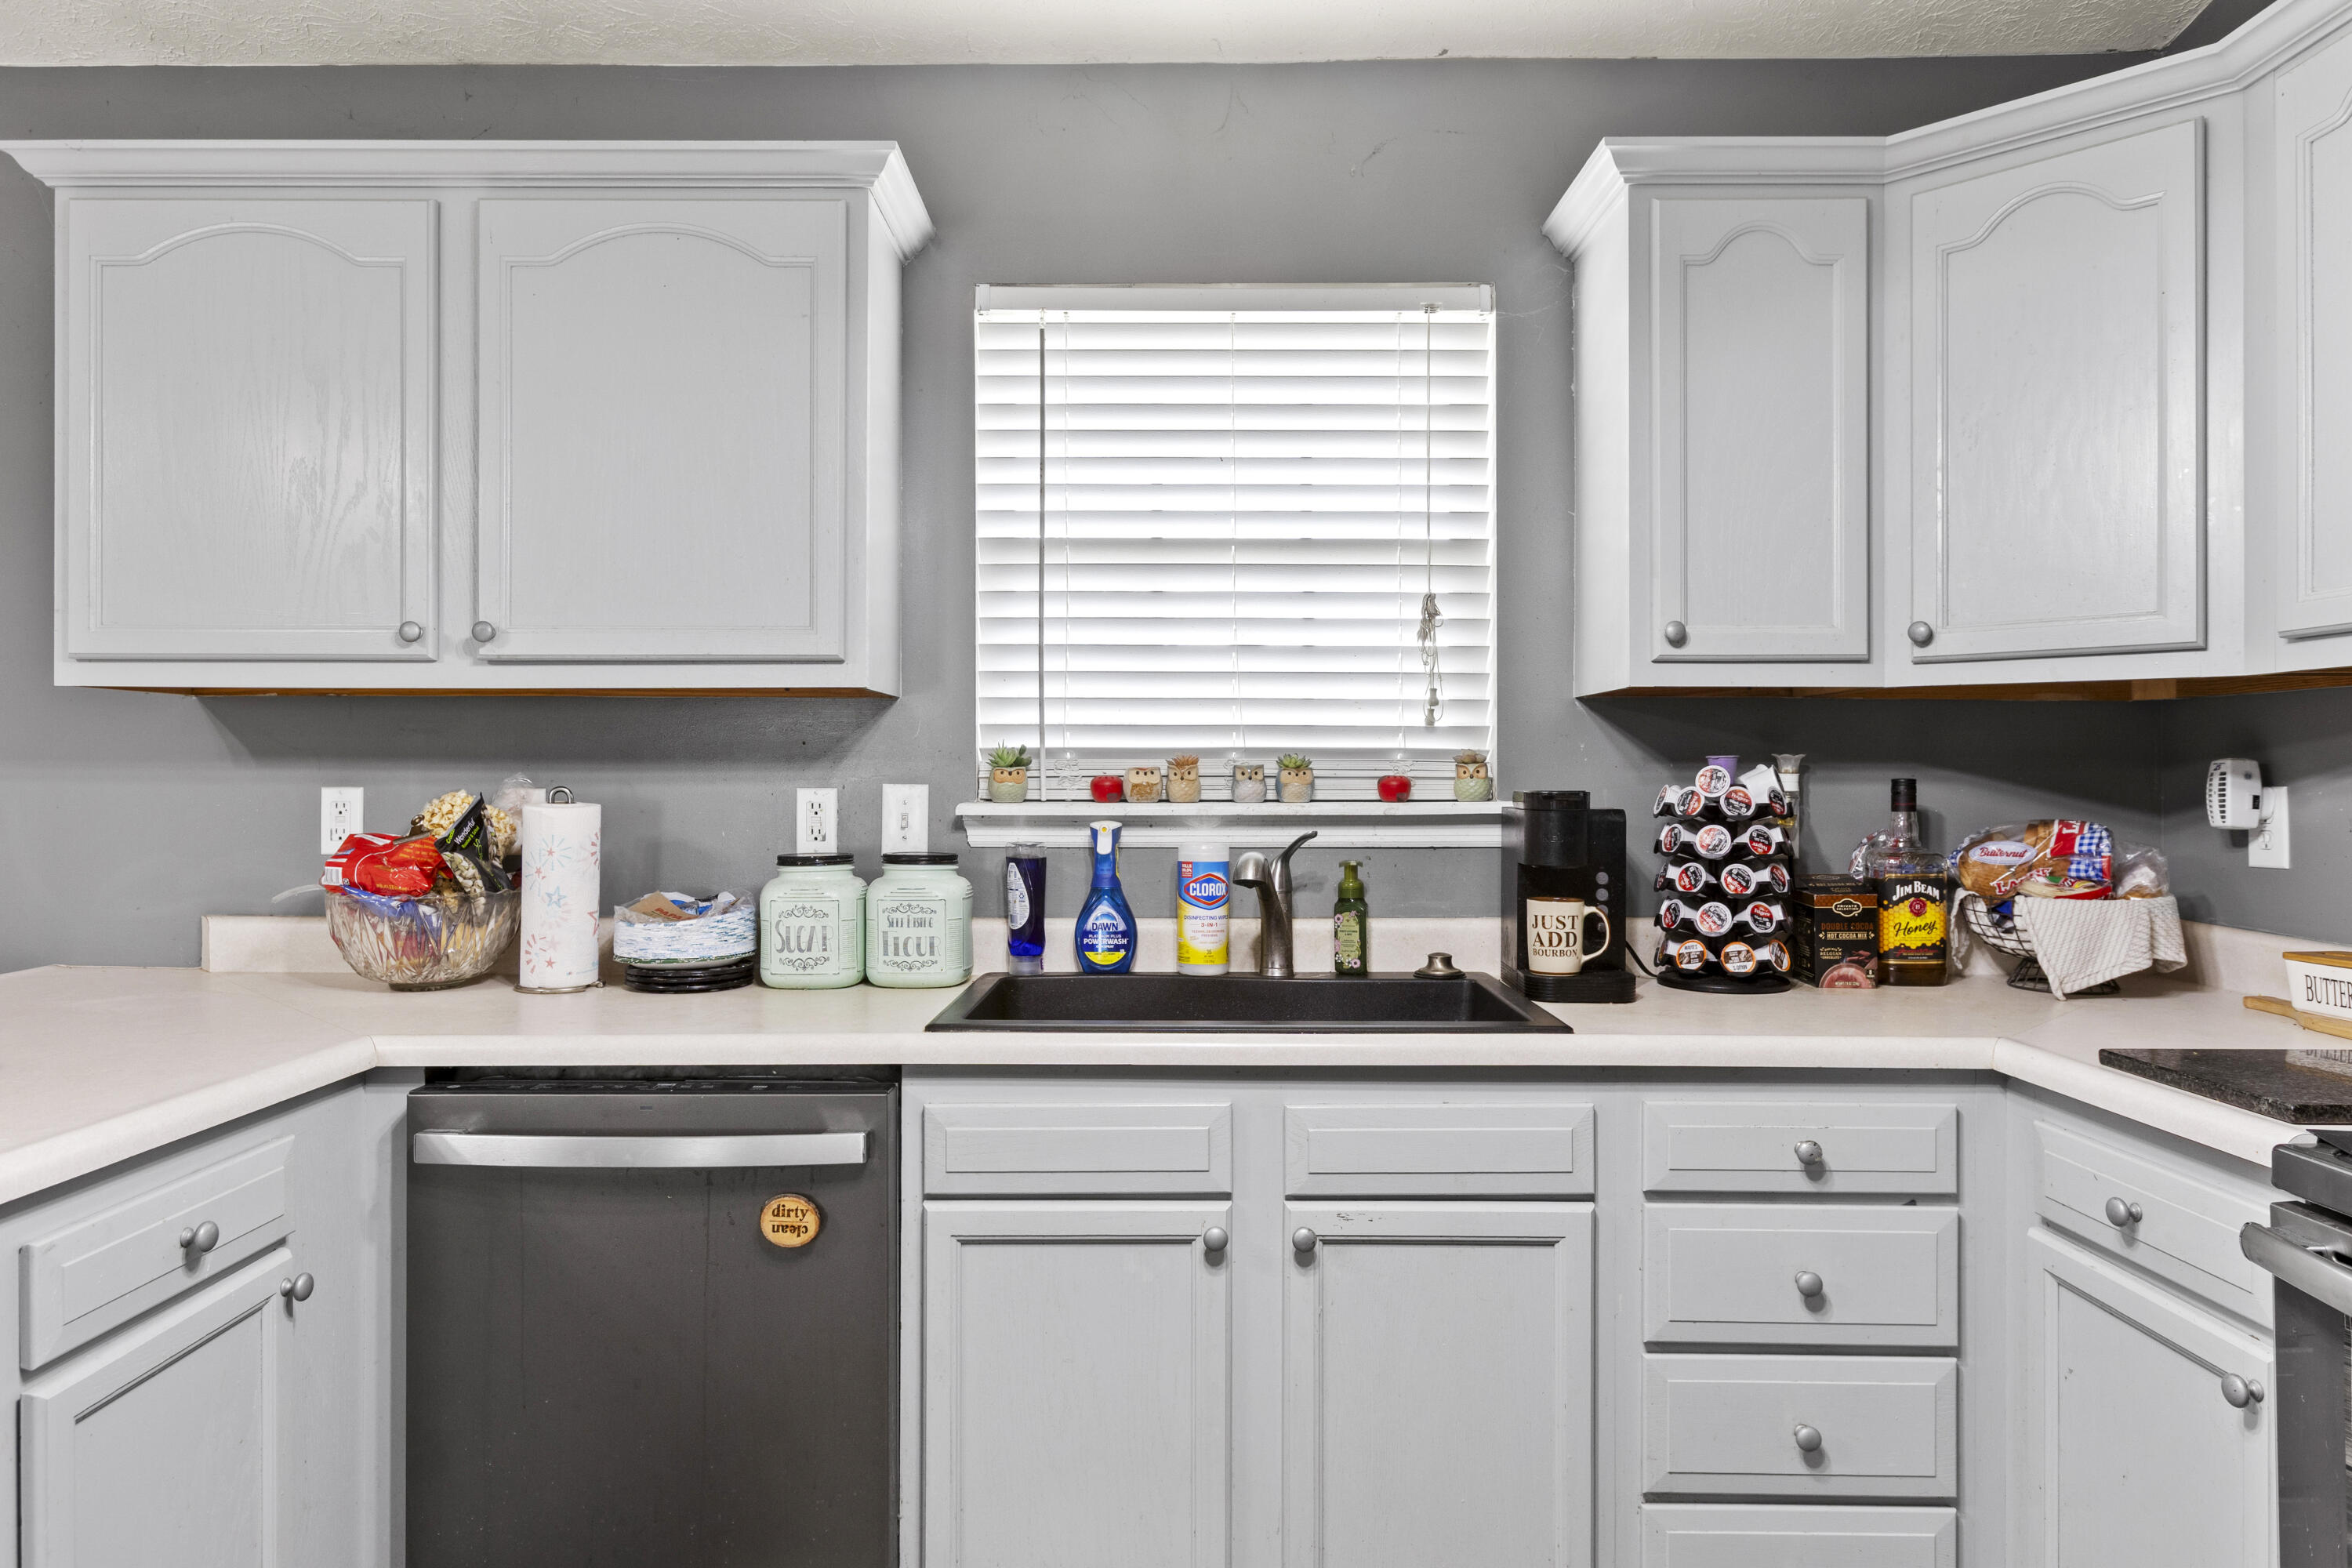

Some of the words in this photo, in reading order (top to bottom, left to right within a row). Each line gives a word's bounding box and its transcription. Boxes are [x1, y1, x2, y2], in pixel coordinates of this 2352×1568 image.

[1730, 792, 1748, 802] Folgers
[454, 818, 476, 844] Wonderful
[1980, 847, 2028, 858] Butternut
[1189, 883, 1226, 896] CLOROX
[1893, 884, 1912, 901] JIM
[1914, 880, 1940, 901] BEAM
[1753, 908, 1770, 916] Folgers
[1091, 922, 1119, 931] DAWN
[1532, 915, 1579, 930] JUST
[1850, 922, 1874, 931] COCOA
[1894, 920, 1937, 937] Honey
[774, 920, 834, 953] SUGAR
[882, 931, 942, 956] FLOUR
[1533, 931, 1577, 948] ADD
[1533, 948, 1577, 957] BOURBON
[2305, 975, 2352, 1009] BUTTER
[771, 1203, 809, 1221] dirty
[771, 1224, 808, 1238] clean
